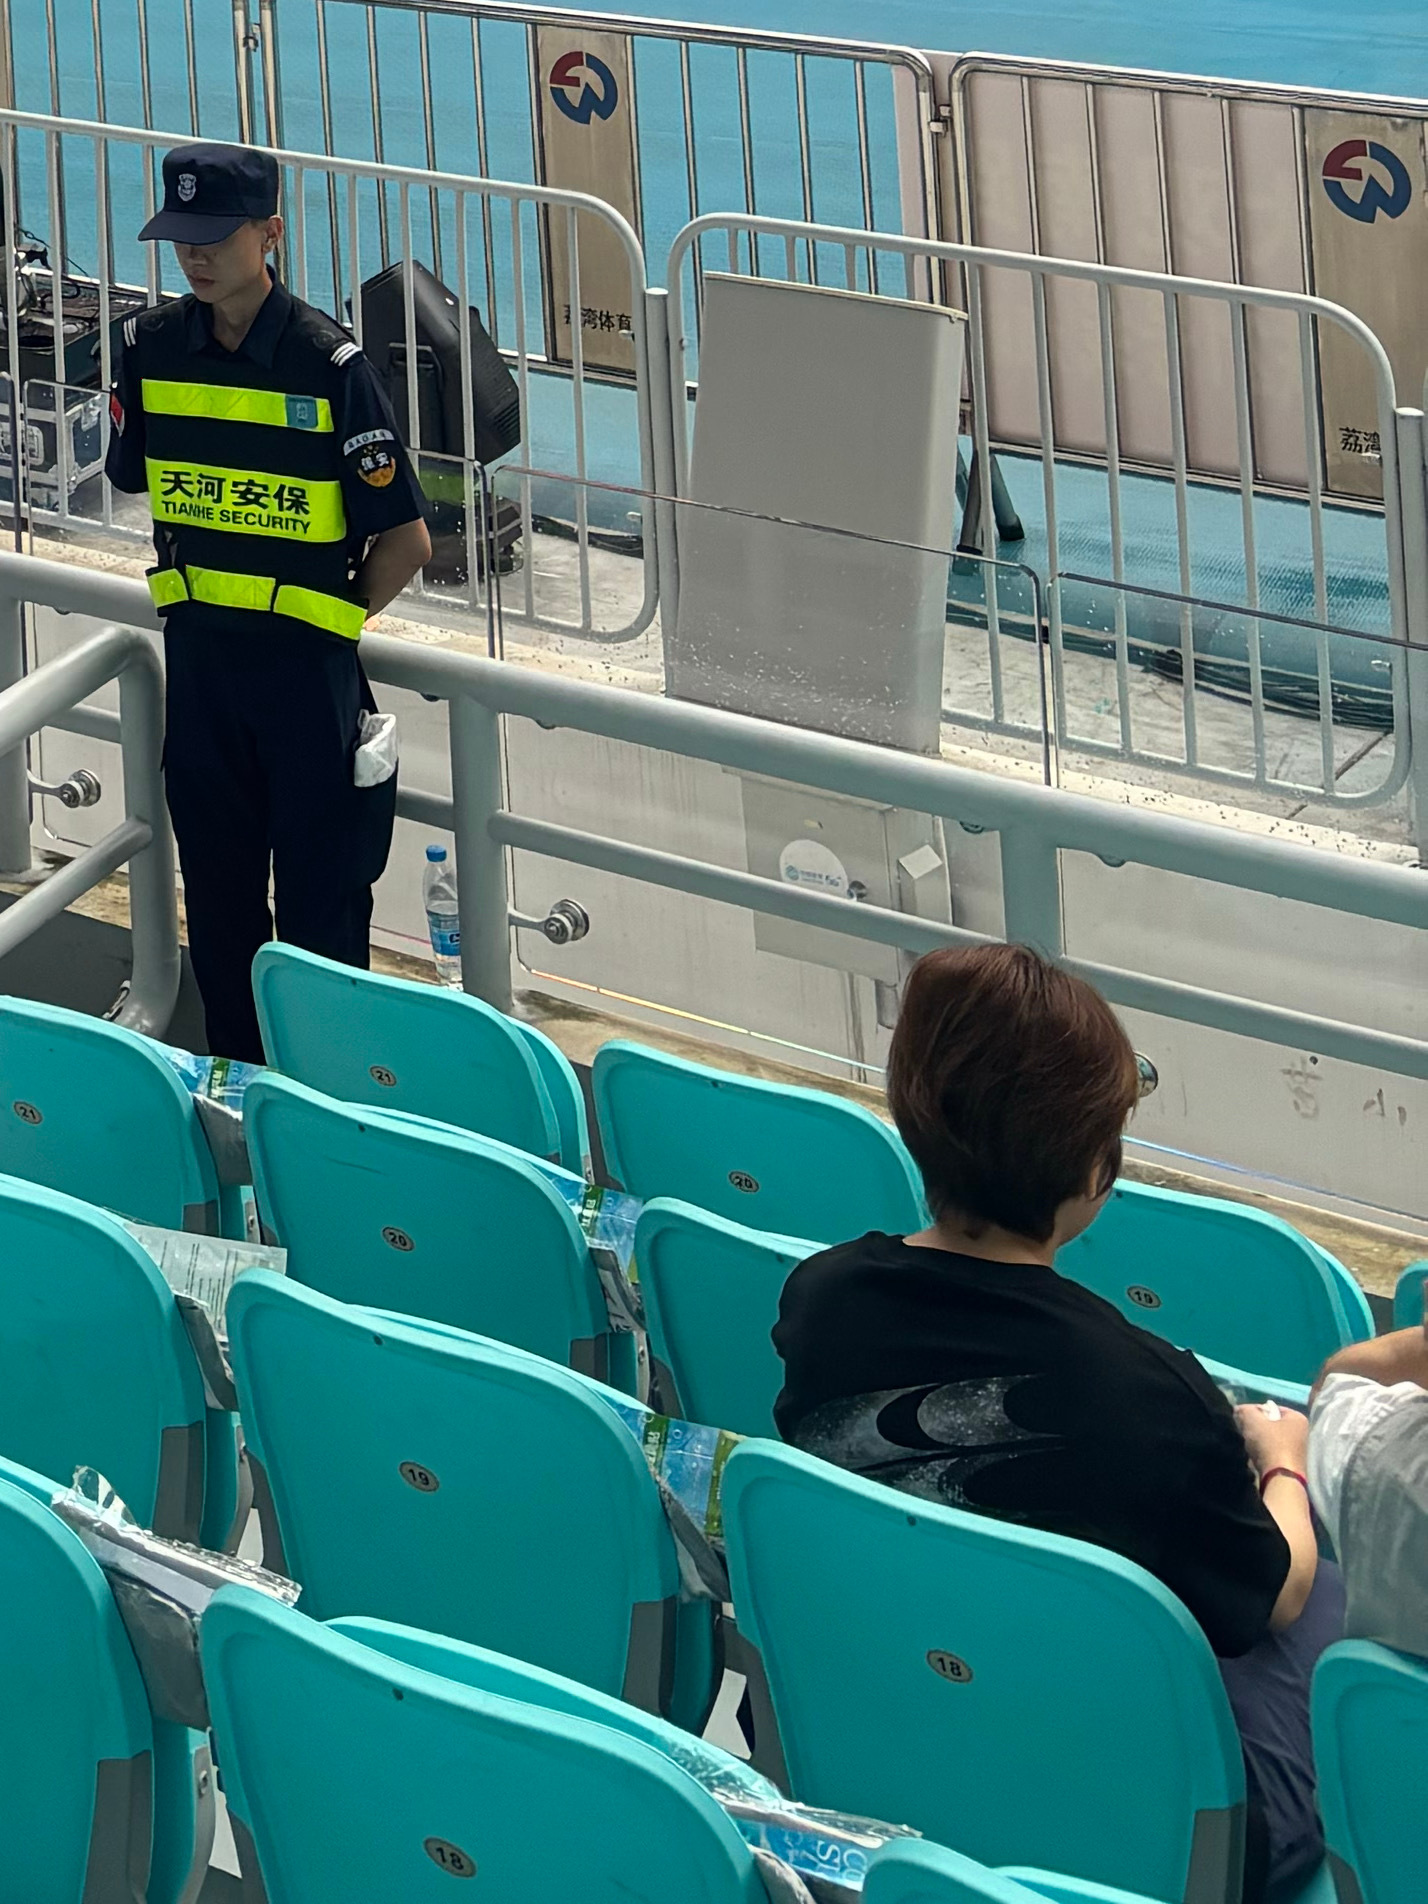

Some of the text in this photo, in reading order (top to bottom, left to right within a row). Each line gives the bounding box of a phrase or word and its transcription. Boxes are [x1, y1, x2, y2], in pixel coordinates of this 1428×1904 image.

[160, 470, 310, 515] 天河安保
[161, 500, 311, 534] TIANHE SECURITY
[375, 1069, 391, 1084] 21
[19, 1104, 37, 1121] 21
[388, 1230, 408, 1248] 20
[408, 1467, 430, 1486] 19
[937, 1656, 962, 1677] 18
[436, 1847, 463, 1870] 18
